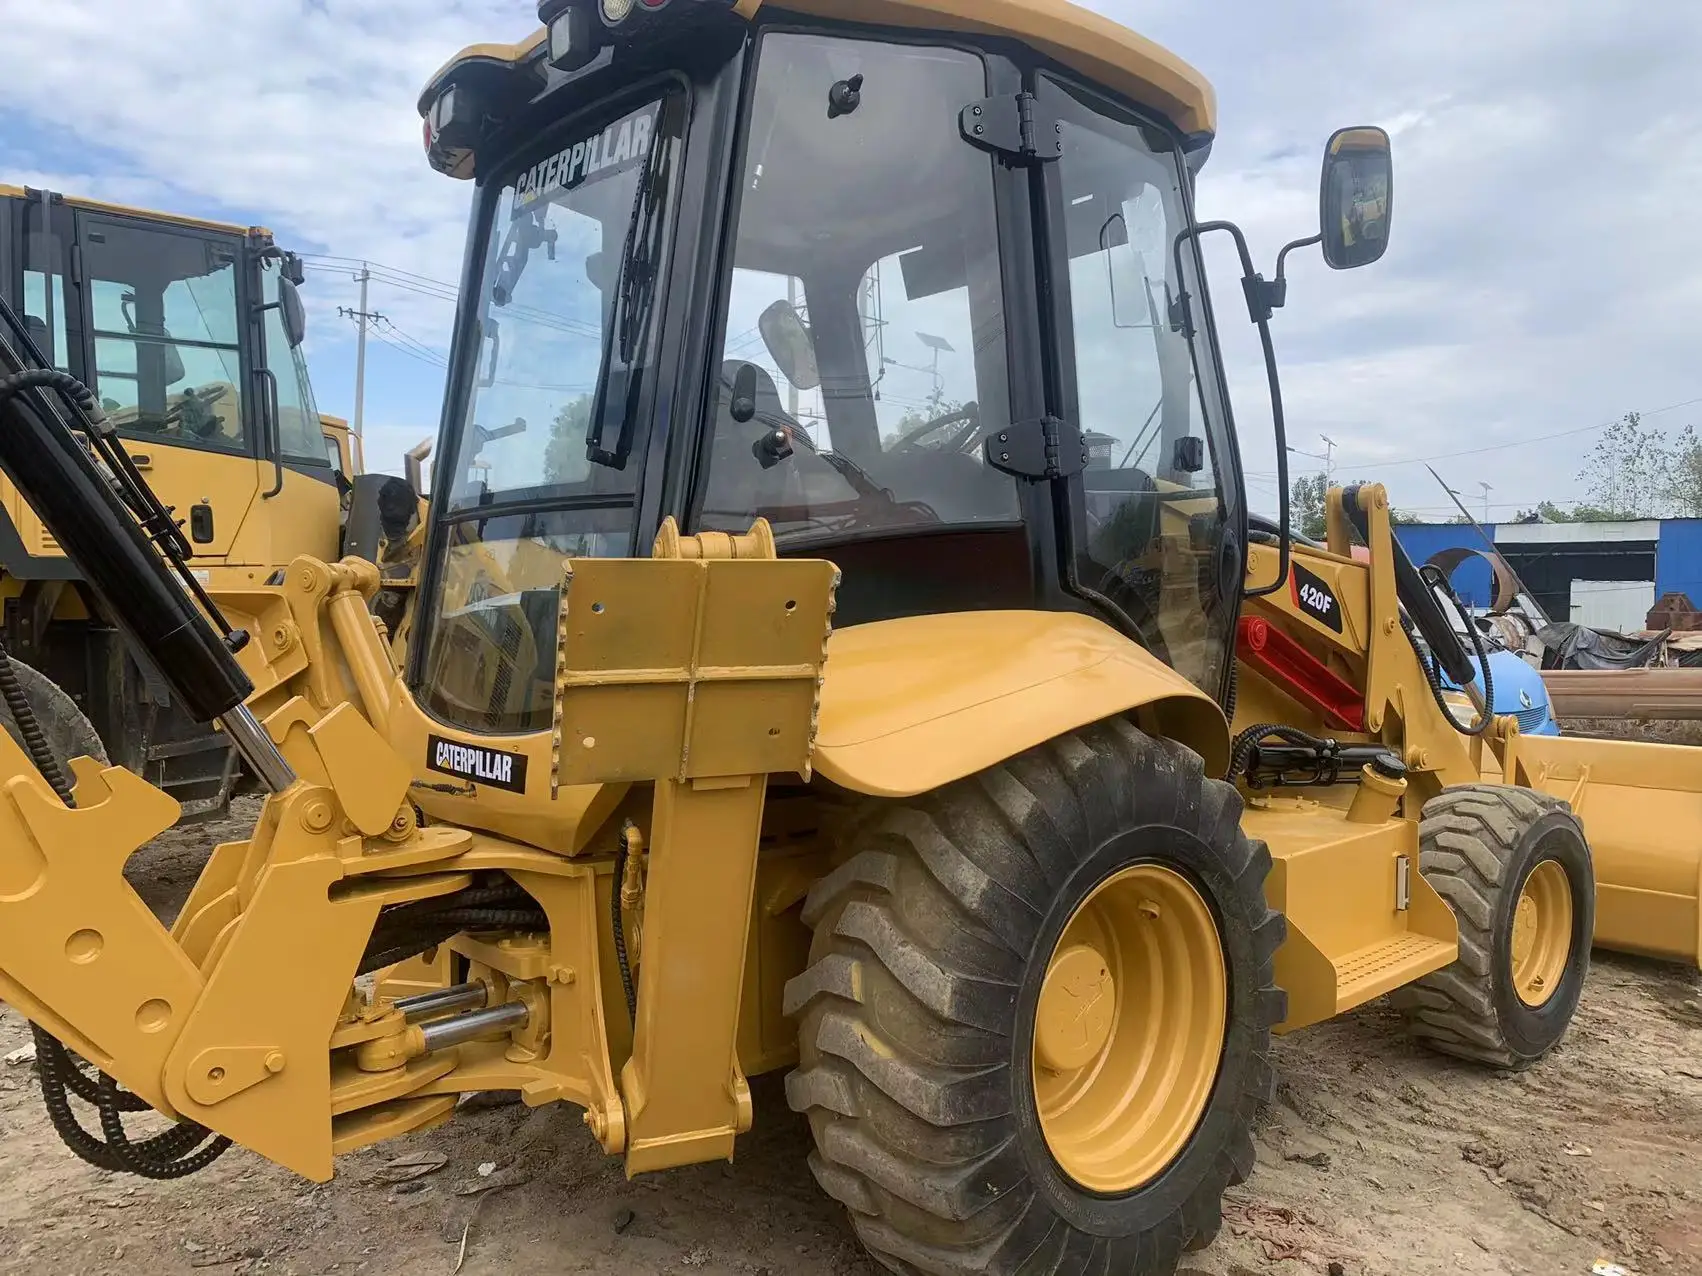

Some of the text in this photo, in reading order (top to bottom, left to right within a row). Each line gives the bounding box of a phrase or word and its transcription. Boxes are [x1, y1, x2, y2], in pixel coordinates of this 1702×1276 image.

[514, 114, 652, 209] CATERPILLAR
[1300, 583, 1332, 613] 420F
[436, 741, 512, 783] CATERPILLAR
